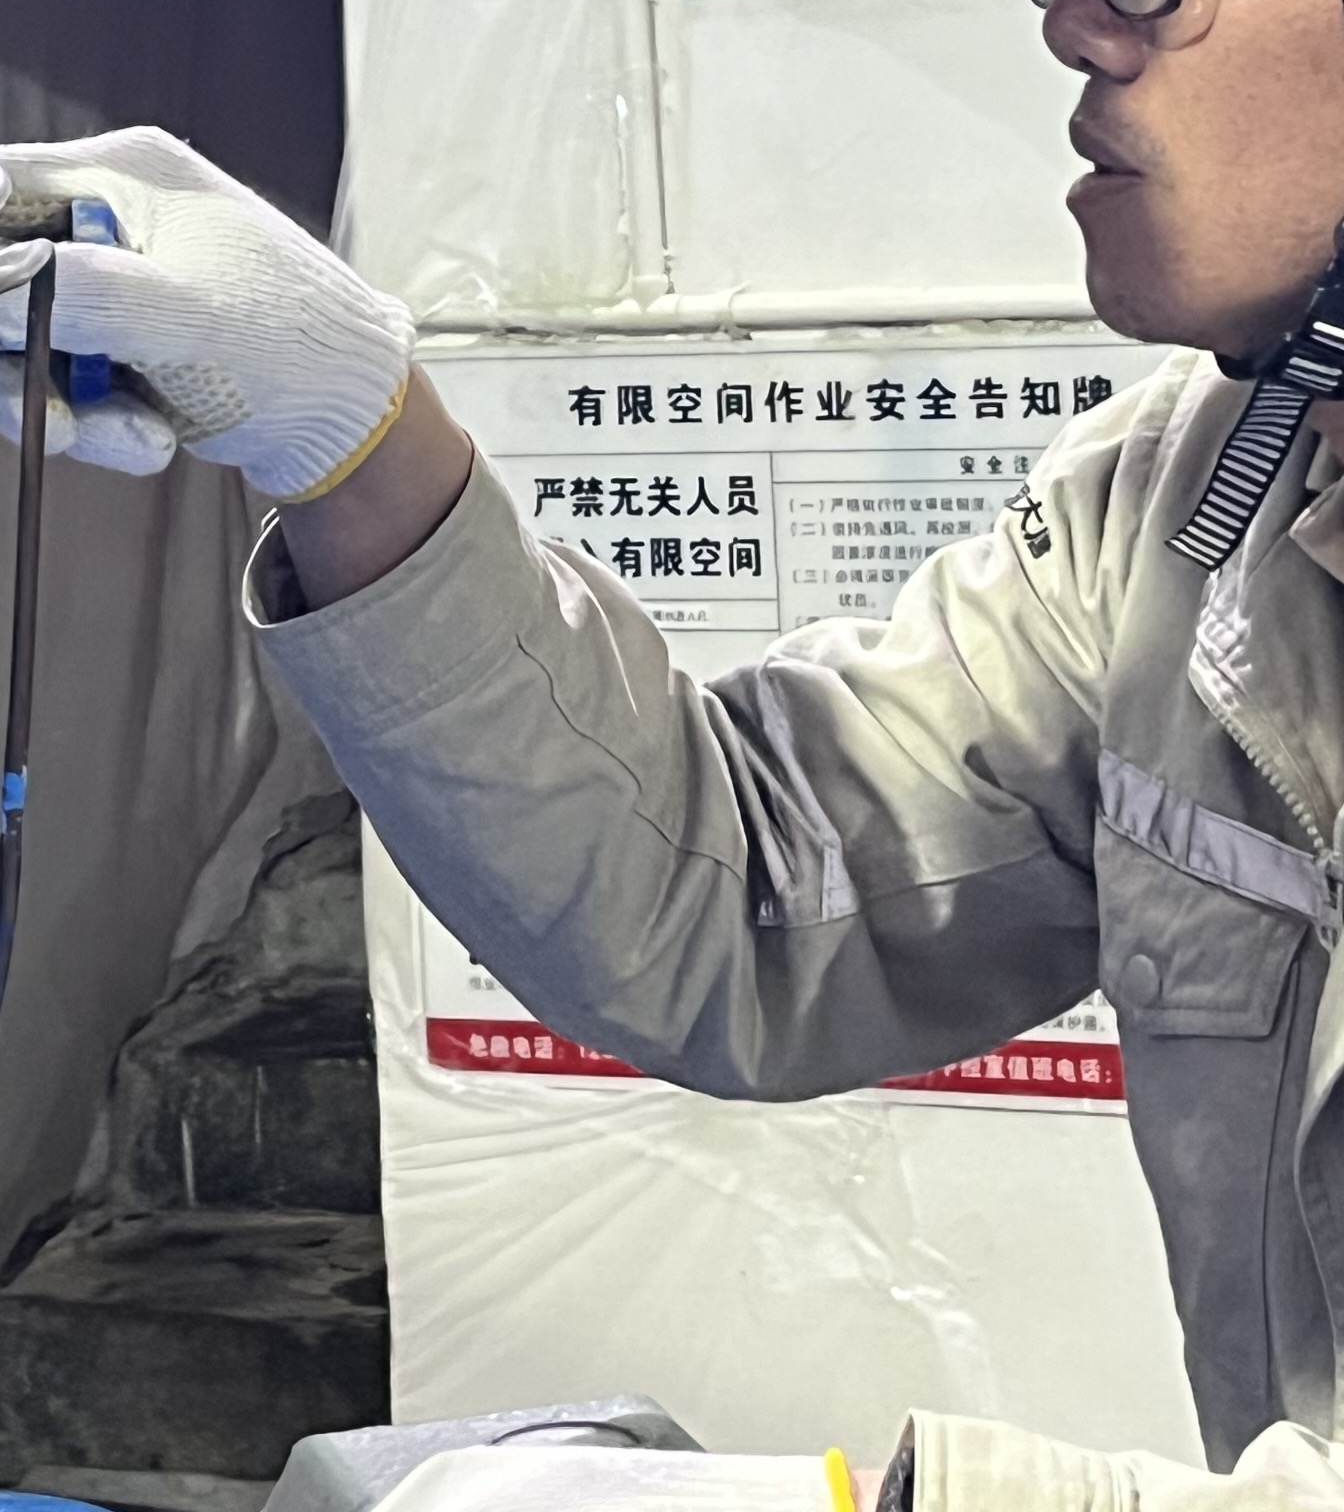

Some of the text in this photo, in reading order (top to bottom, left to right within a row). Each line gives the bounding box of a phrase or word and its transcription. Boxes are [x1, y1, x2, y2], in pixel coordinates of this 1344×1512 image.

[567, 374, 1112, 426] 有限空间作业安全告知牌
[534, 475, 760, 518] 严禁无关人员
[551, 536, 762, 578] 有限空间
